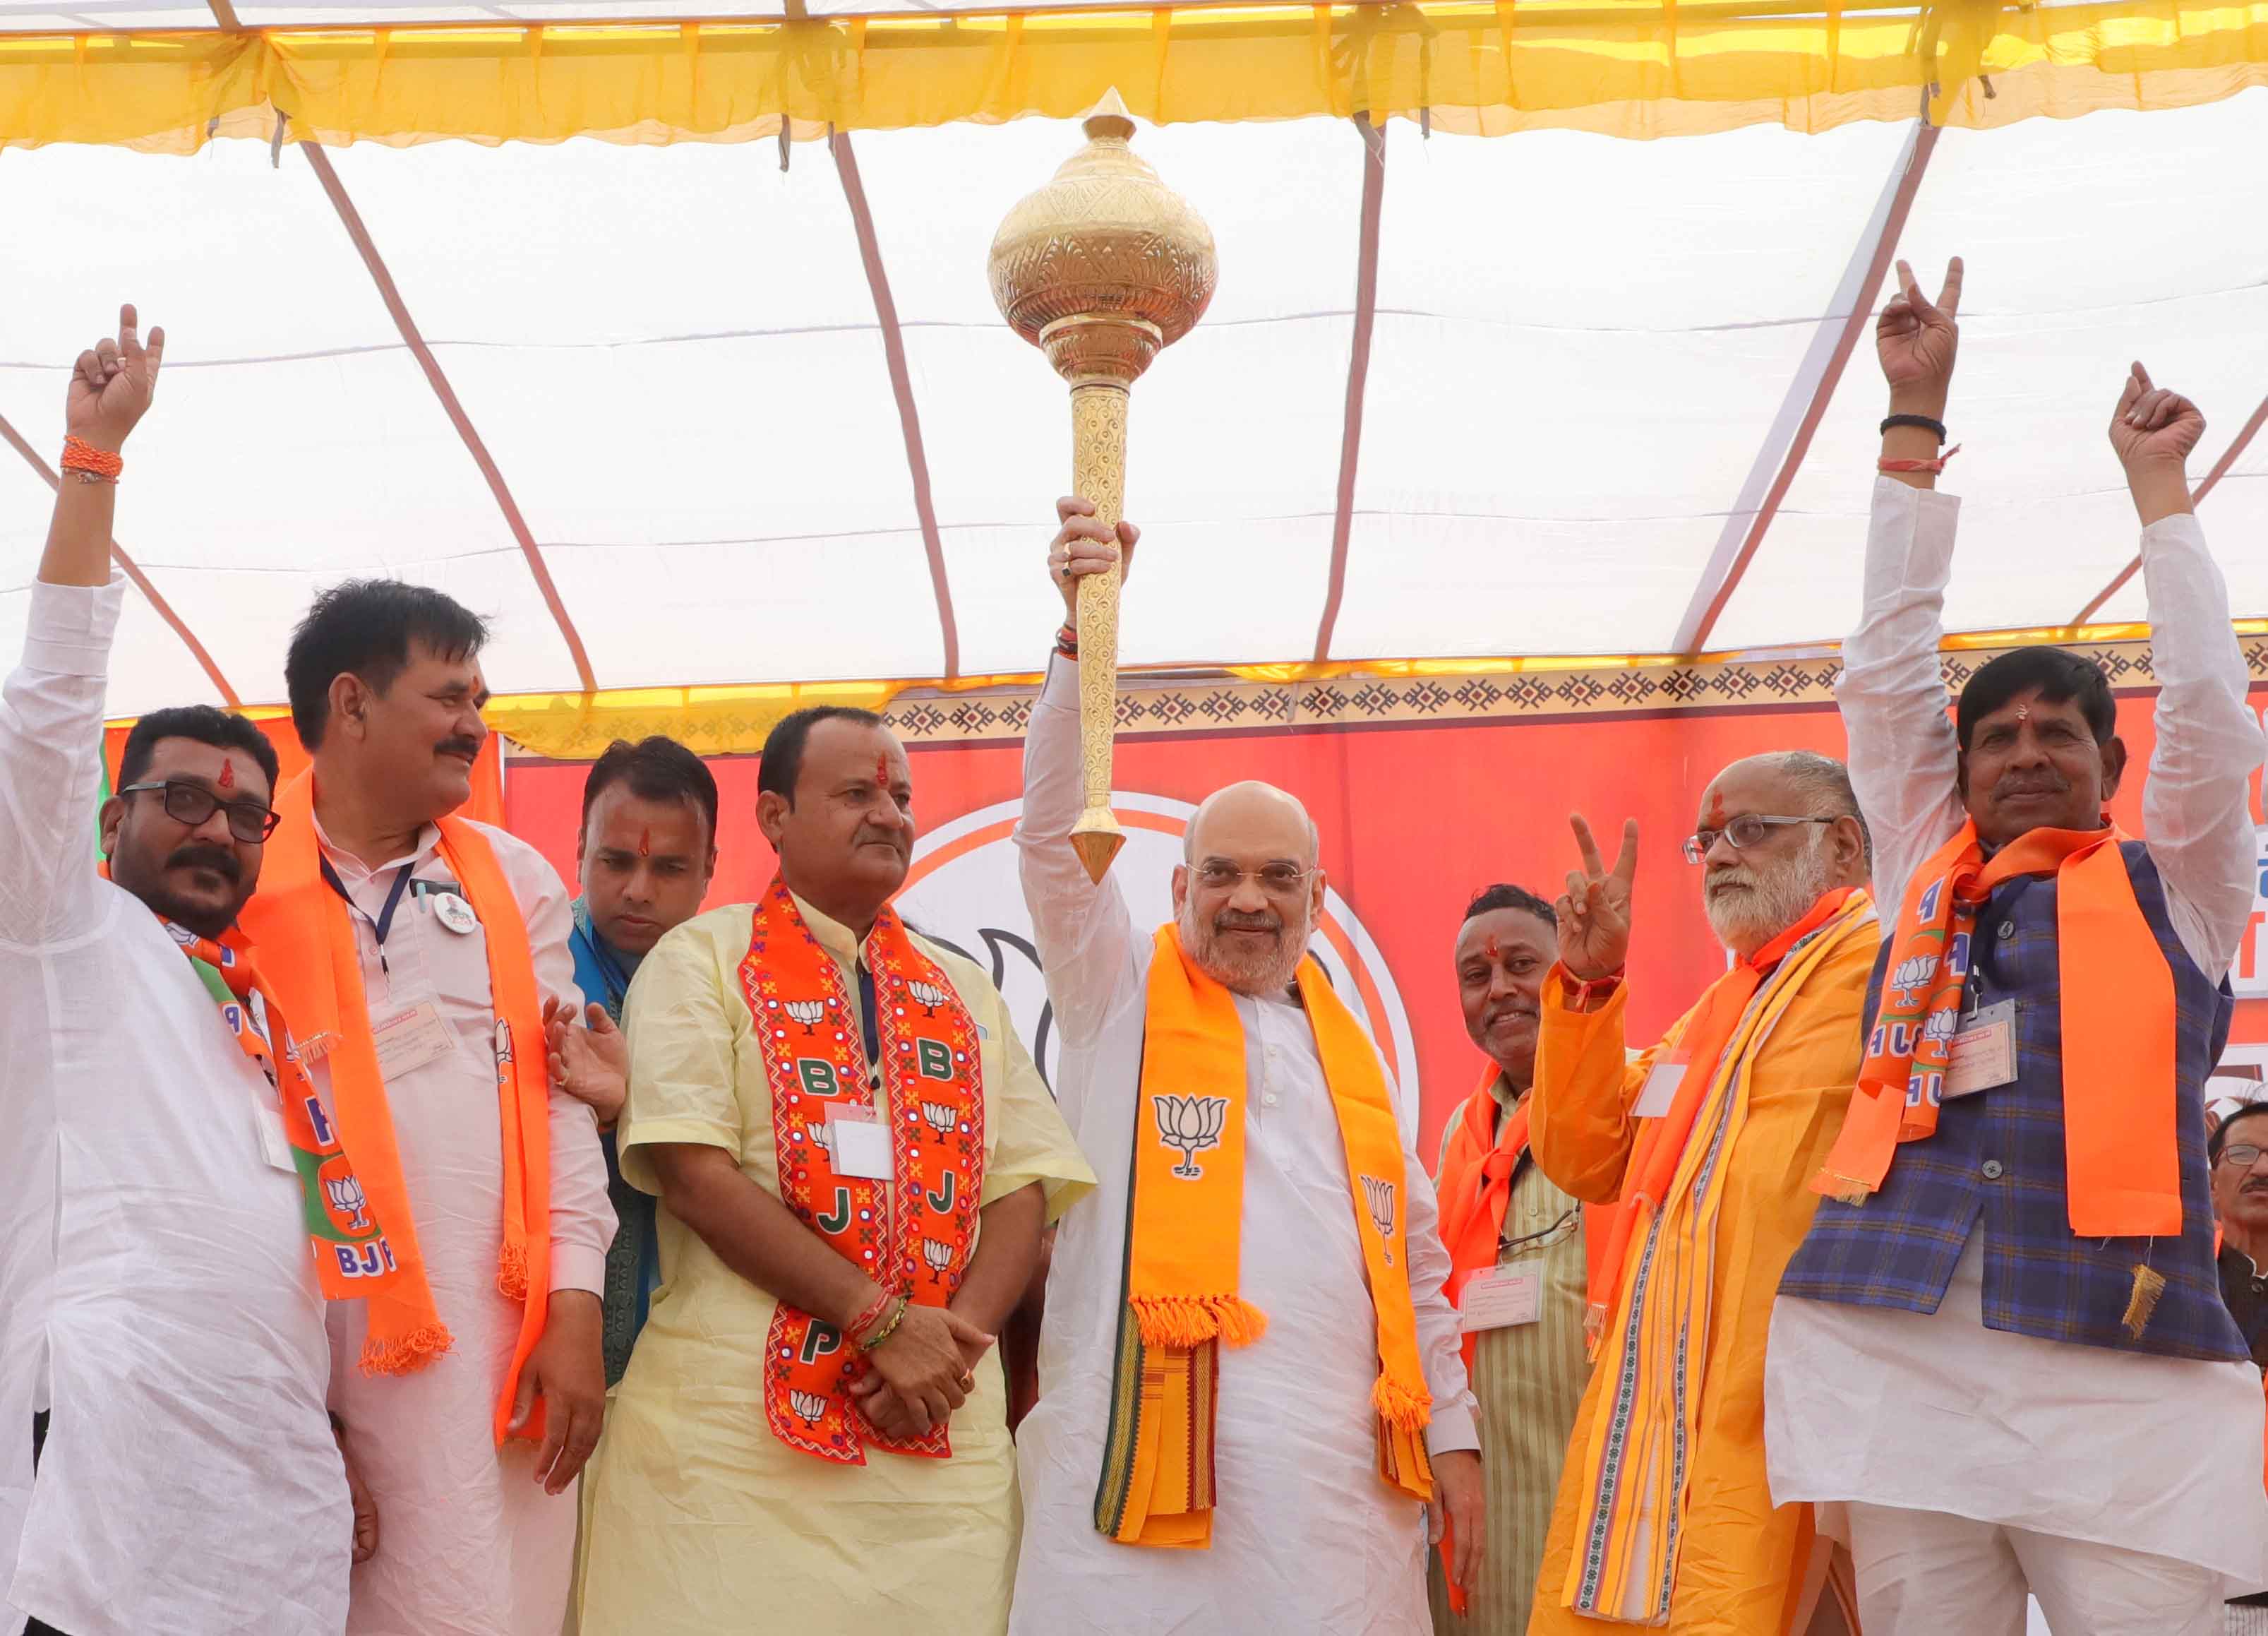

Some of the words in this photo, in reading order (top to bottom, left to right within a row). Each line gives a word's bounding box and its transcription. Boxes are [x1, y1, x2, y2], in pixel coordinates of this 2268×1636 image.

[797, 1057, 840, 1097] B
[916, 1037, 954, 1082] B
[815, 1186, 851, 1236] J
[925, 1169, 955, 1215] J
[799, 1317, 843, 1366] P
